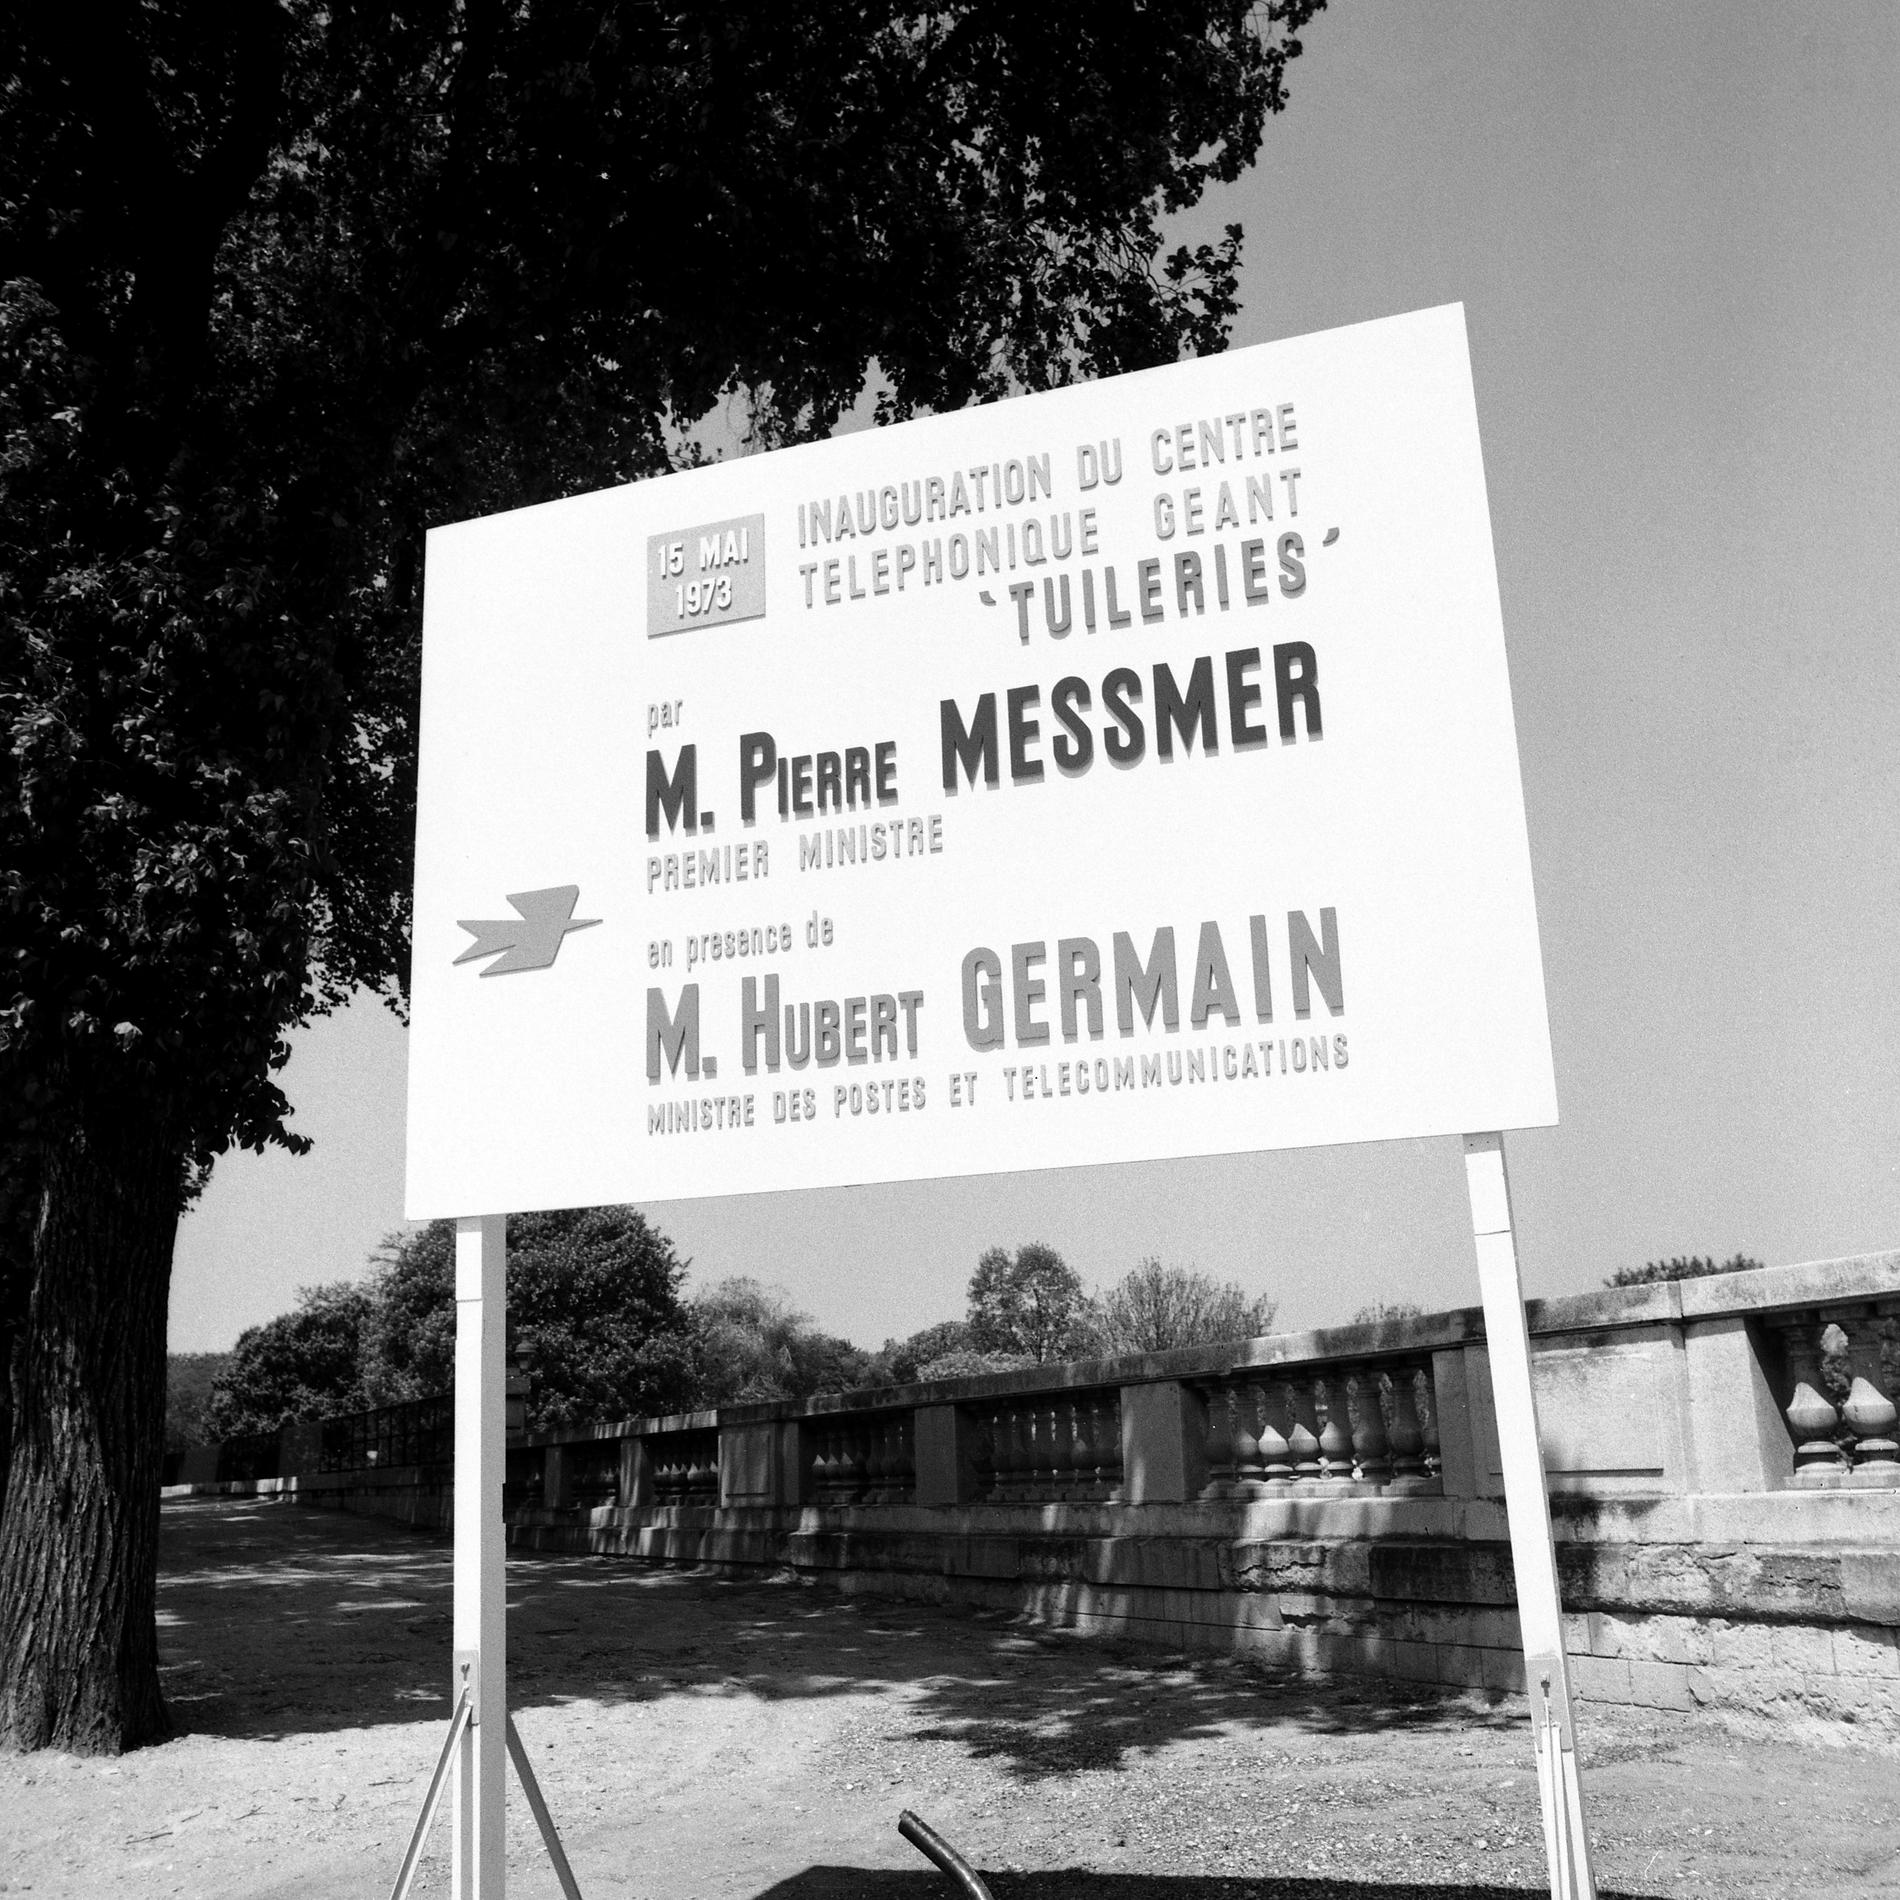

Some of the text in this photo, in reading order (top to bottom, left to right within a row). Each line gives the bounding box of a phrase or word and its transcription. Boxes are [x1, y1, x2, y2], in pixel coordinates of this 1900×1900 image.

[798, 402, 1299, 549] INAUGURATION DU CENTRE
[658, 528, 748, 580] 15 MAI
[798, 468, 1301, 608] TELEPHONIQUE GEANT
[676, 576, 732, 619] 1973
[645, 640, 1323, 843] M. PIERRE MESSMER
[648, 700, 683, 739] par
[647, 814, 943, 894] PREMIER MINISTRE
[648, 910, 834, 973] en presence de
[646, 906, 1345, 1086] M. HUBERT GERMAIN
[648, 1034, 1349, 1136] MINISTRE DES POSTES ET TELECOMMUNICATIONS
